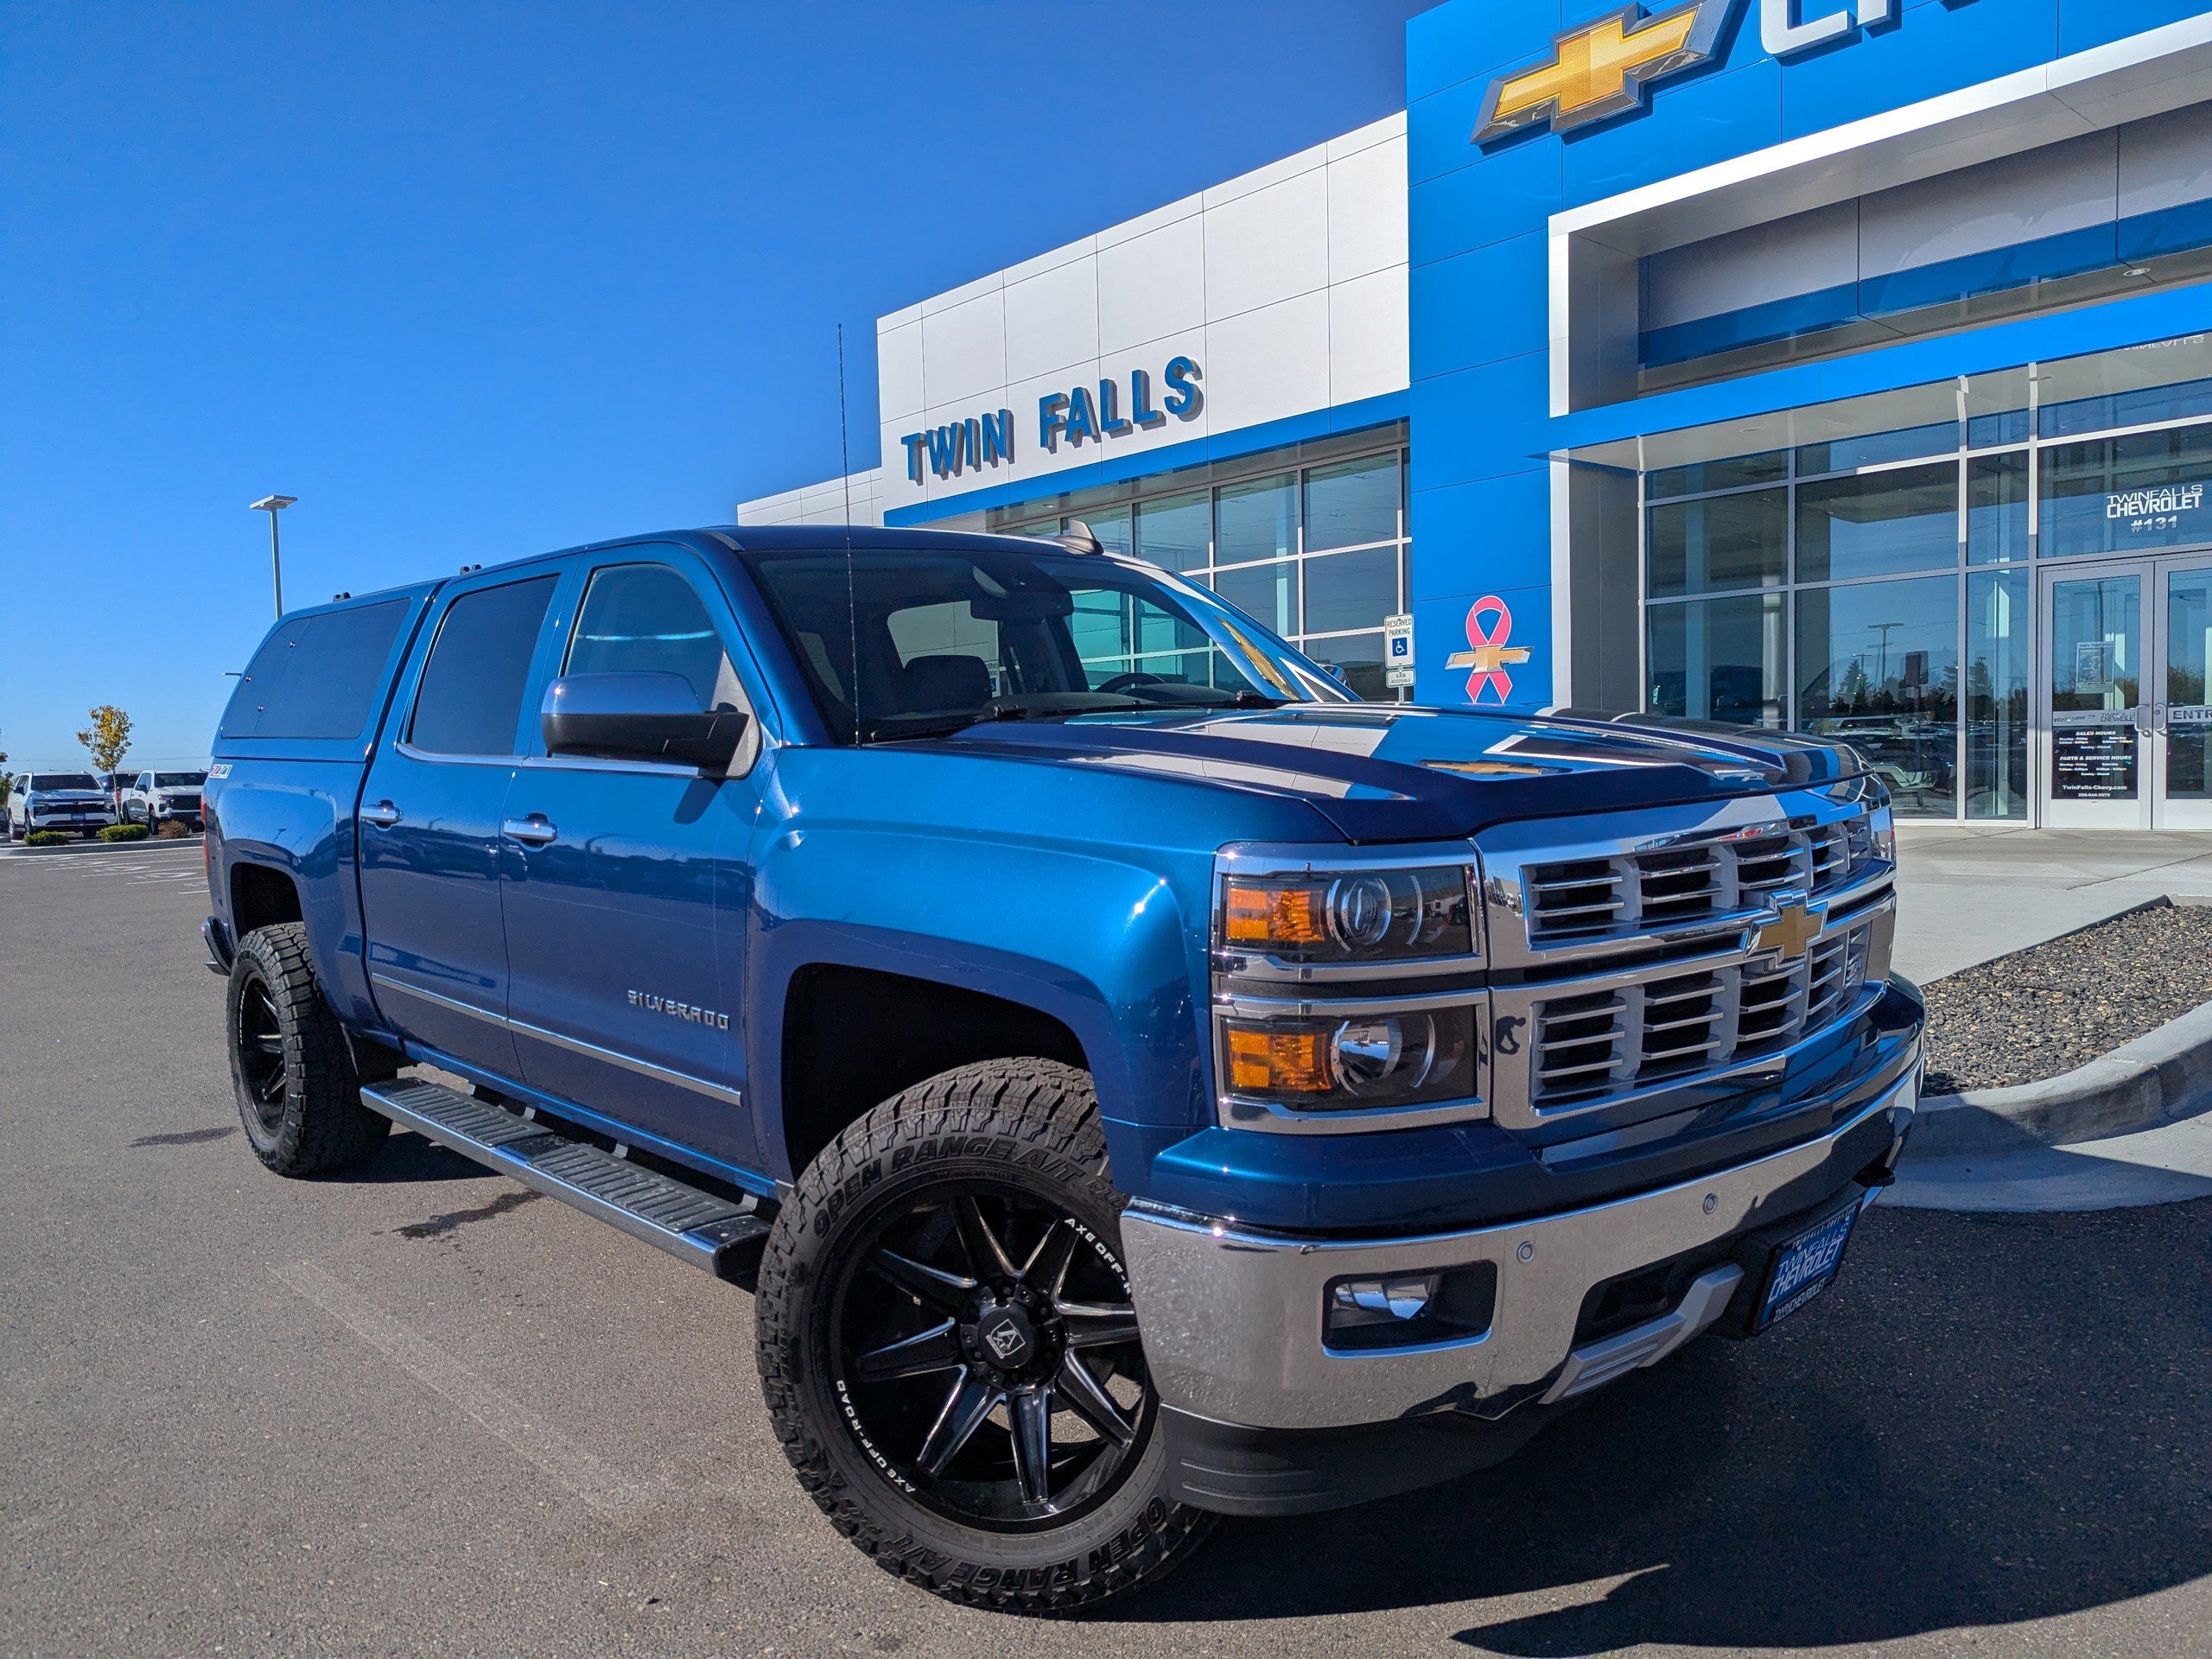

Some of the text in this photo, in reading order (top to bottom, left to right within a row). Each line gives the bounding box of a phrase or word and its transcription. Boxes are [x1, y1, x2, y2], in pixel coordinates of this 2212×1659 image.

[901, 356, 1204, 486] TWIN FALLS
[2107, 484, 2202, 505] TWINFALLS
[2107, 493, 2202, 518] CHEVROLET
[2131, 515, 2177, 533] #131
[1387, 618, 1412, 628] RESERVED
[1389, 628, 1410, 637] PARKING
[2173, 709, 2212, 720] ENTR
[208, 764, 232, 779] Z71
[628, 989, 729, 1031] SILVERADO
[813, 1157, 882, 1238] OPEN
[891, 1135, 1017, 1173] RANGE
[1014, 1147, 1086, 1181] A/T
[1064, 1217, 1096, 1243] AXE
[1777, 1222, 1849, 1279] TWINFALLS
[1767, 1236, 1844, 1305] CHEVROLET
[836, 1380, 887, 1468] OFF-ROAD
[887, 1468, 916, 1493] AXE
